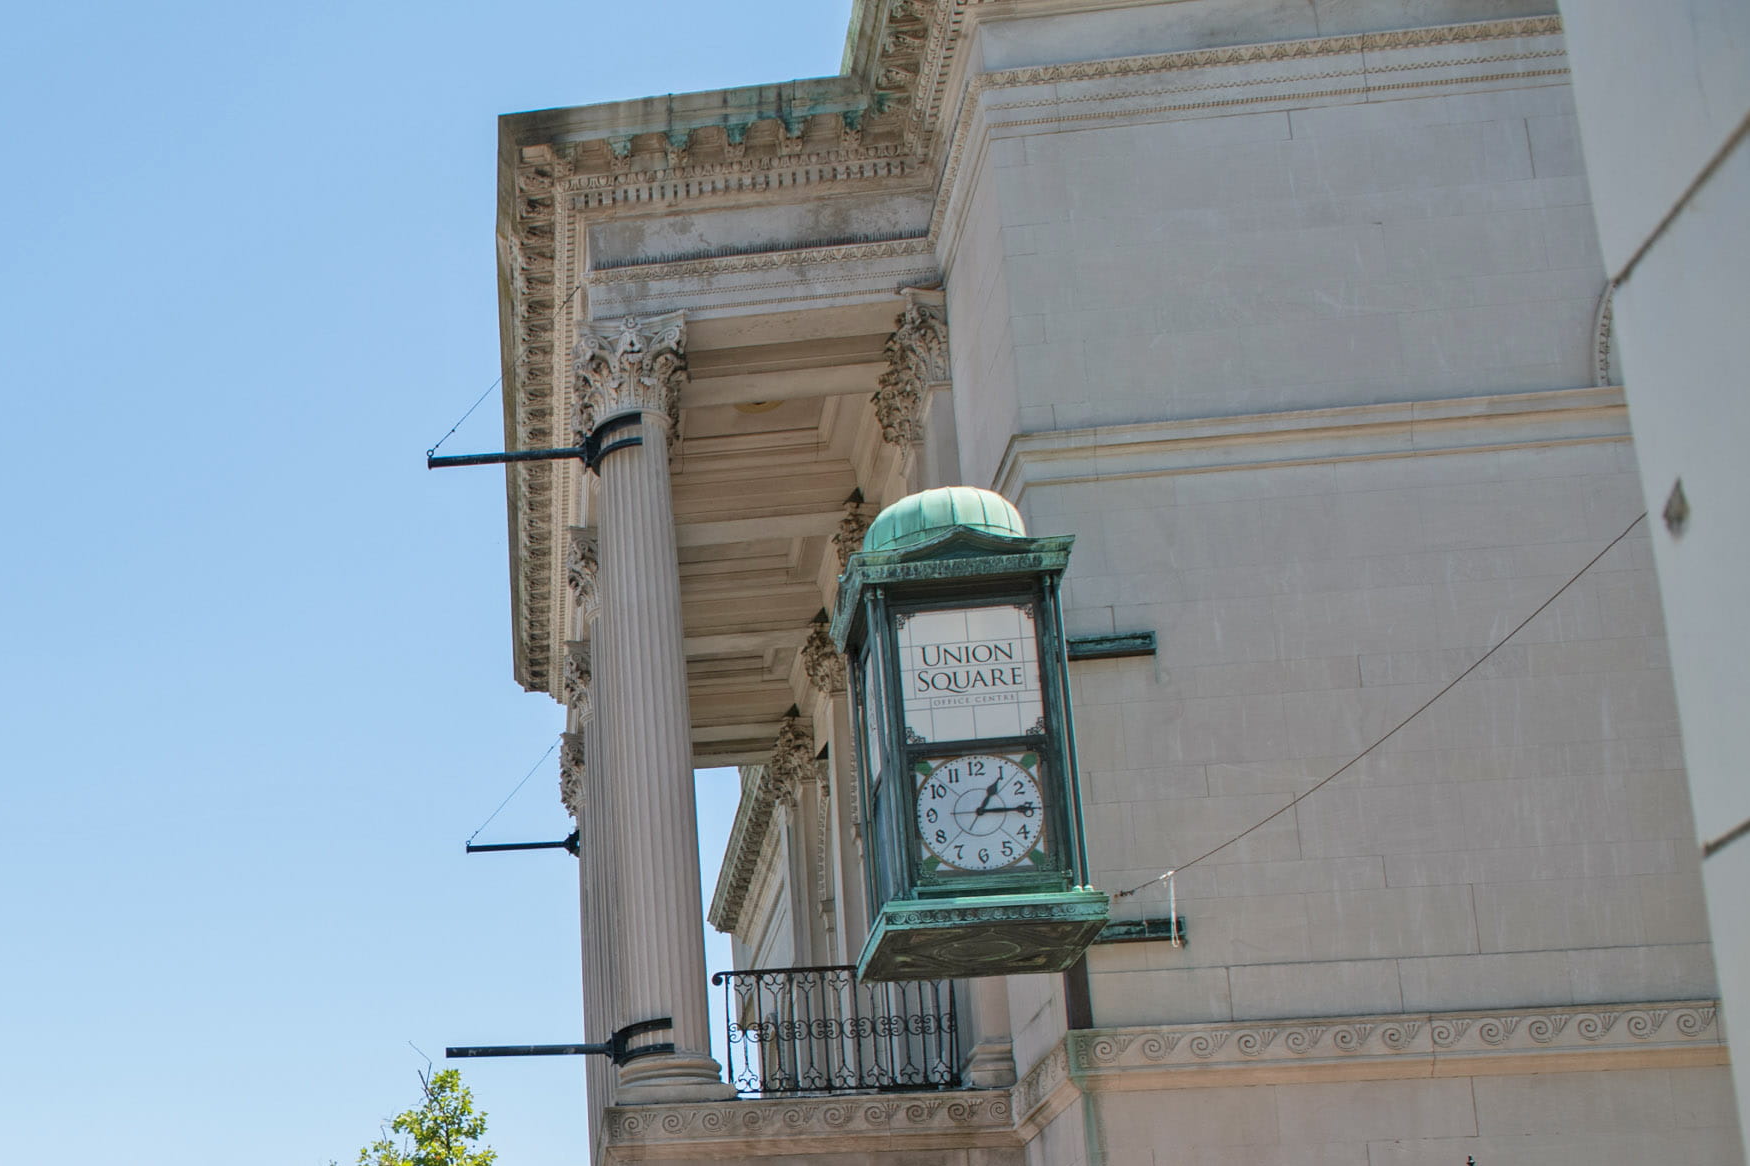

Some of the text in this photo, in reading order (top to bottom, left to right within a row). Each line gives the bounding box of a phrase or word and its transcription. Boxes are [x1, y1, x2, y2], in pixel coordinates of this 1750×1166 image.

[921, 642, 1013, 667] UNION
[917, 667, 1023, 693] SQUARE
[933, 693, 1015, 707] OFFICE CENTRE
[948, 768, 959, 783] 11
[967, 761, 986, 776] 12
[930, 784, 947, 800] 10
[1013, 780, 1025, 795] 2
[926, 808, 938, 823] 9
[935, 829, 947, 844] 8
[1016, 824, 1031, 840] 4
[954, 844, 964, 860] 7
[978, 848, 989, 864] 6
[1001, 840, 1013, 856] 5
